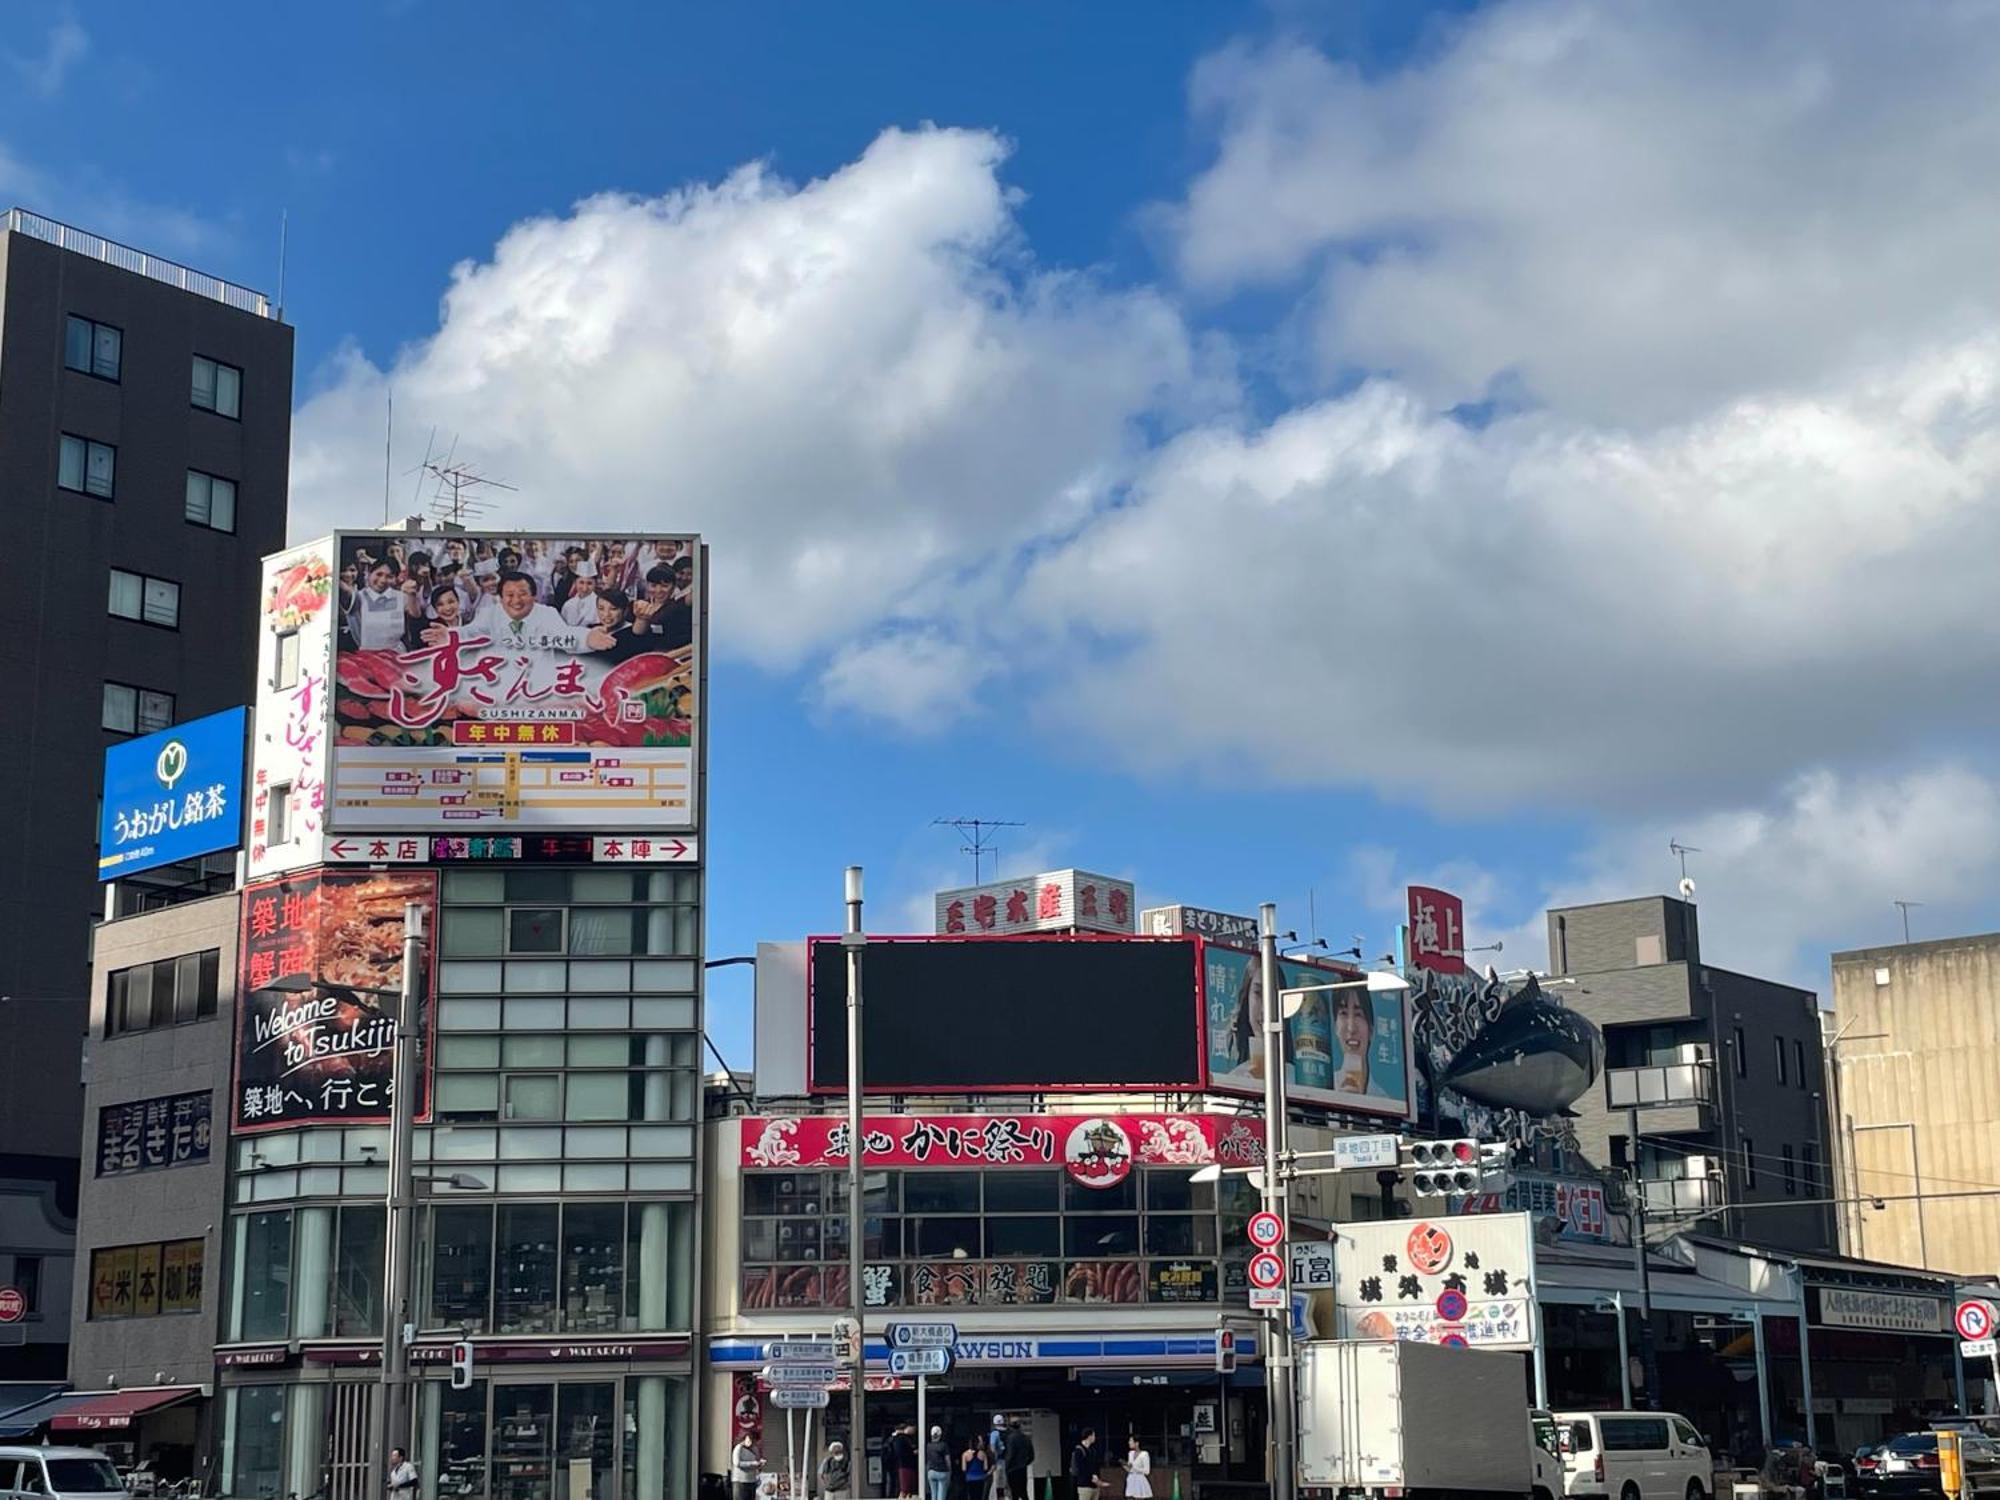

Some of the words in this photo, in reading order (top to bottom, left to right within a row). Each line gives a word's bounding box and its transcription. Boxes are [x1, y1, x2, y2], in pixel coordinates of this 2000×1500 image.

[501, 634, 576, 649] つきじ喜代村
[480, 709, 585, 719] SUSHIZANMAI
[468, 723, 560, 742] 年中無休
[113, 783, 226, 845] うおがし銘茶
[368, 839, 418, 860] 本店
[603, 838, 652, 859] 本陣
[252, 894, 306, 939] 築地
[945, 882, 1062, 934] 三宅水産
[1412, 895, 1464, 957] 極上
[254, 997, 337, 1043] Welcome
[1208, 963, 1229, 1058] 晴れ風
[284, 1041, 304, 1067] to
[103, 1125, 192, 1171] まるきた
[902, 1119, 1055, 1163] かに祭り
[1256, 1221, 1276, 1238] 50
[863, 1265, 893, 1305] 蟹
[911, 1264, 1051, 1294] 食べ放題
[954, 1342, 1032, 1359] AWSON
